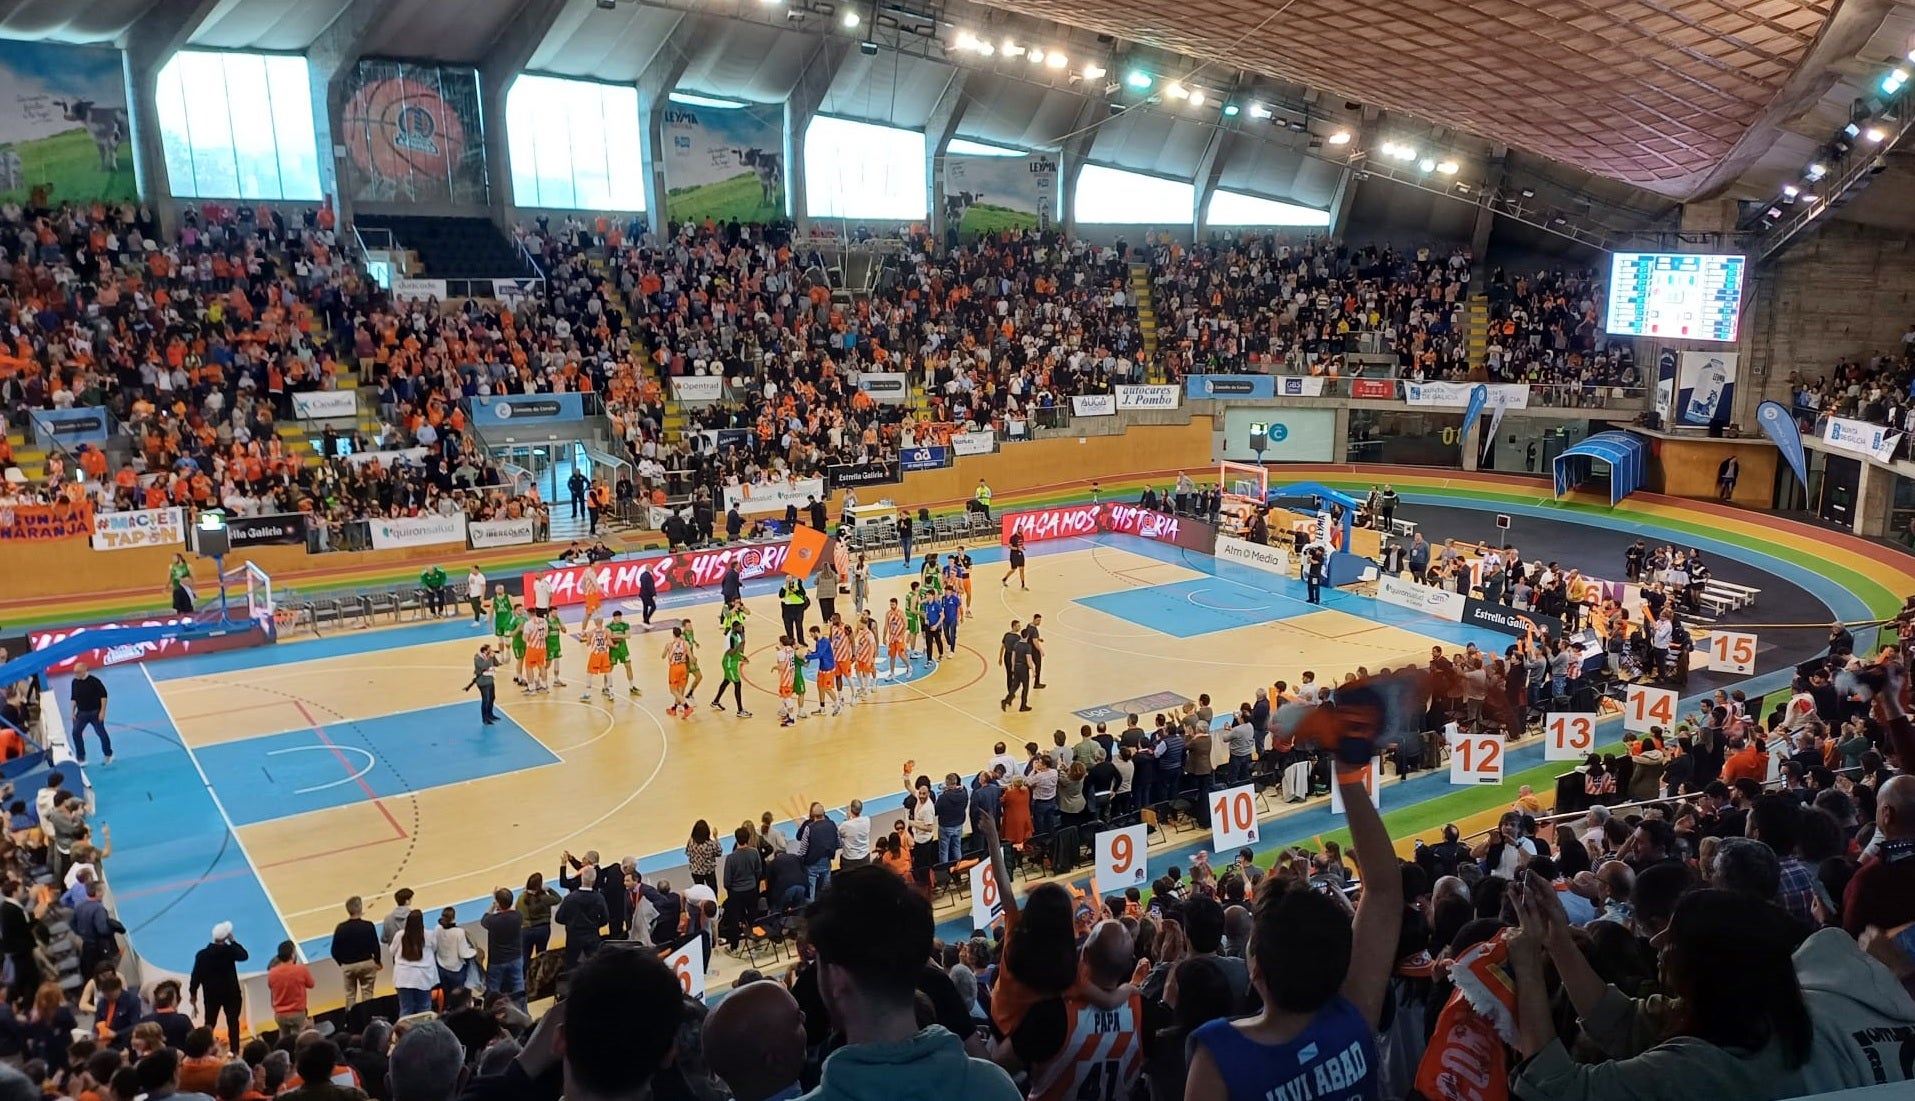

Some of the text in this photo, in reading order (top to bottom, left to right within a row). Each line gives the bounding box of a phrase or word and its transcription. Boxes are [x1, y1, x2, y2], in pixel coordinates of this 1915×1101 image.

[665, 111, 698, 125] LEYMA
[1030, 162, 1057, 173] LEYMA
[683, 381, 719, 391] Opentrad
[1122, 386, 1172, 395] autocares
[1080, 396, 1107, 407] AUGA
[1121, 394, 1172, 405] J. Pombo
[838, 470, 884, 482] Estrella Galicia
[0, 521, 88, 539] NARANJA
[247, 526, 283, 539] Galicia
[1251, 550, 1279, 566] Media
[1474, 608, 1505, 625] Estrella
[1714, 635, 1753, 664] 15
[1630, 690, 1672, 725] 14
[1550, 717, 1591, 749] 13
[1455, 738, 1500, 773] 12
[1214, 791, 1254, 835] 10
[1110, 833, 1134, 874] 9
[981, 863, 998, 907] 8
[673, 955, 691, 994] 6
[1094, 1011, 1121, 1034] PAPA
[1313, 1040, 1368, 1097] ABAD
[1077, 1060, 1120, 1101] 41
